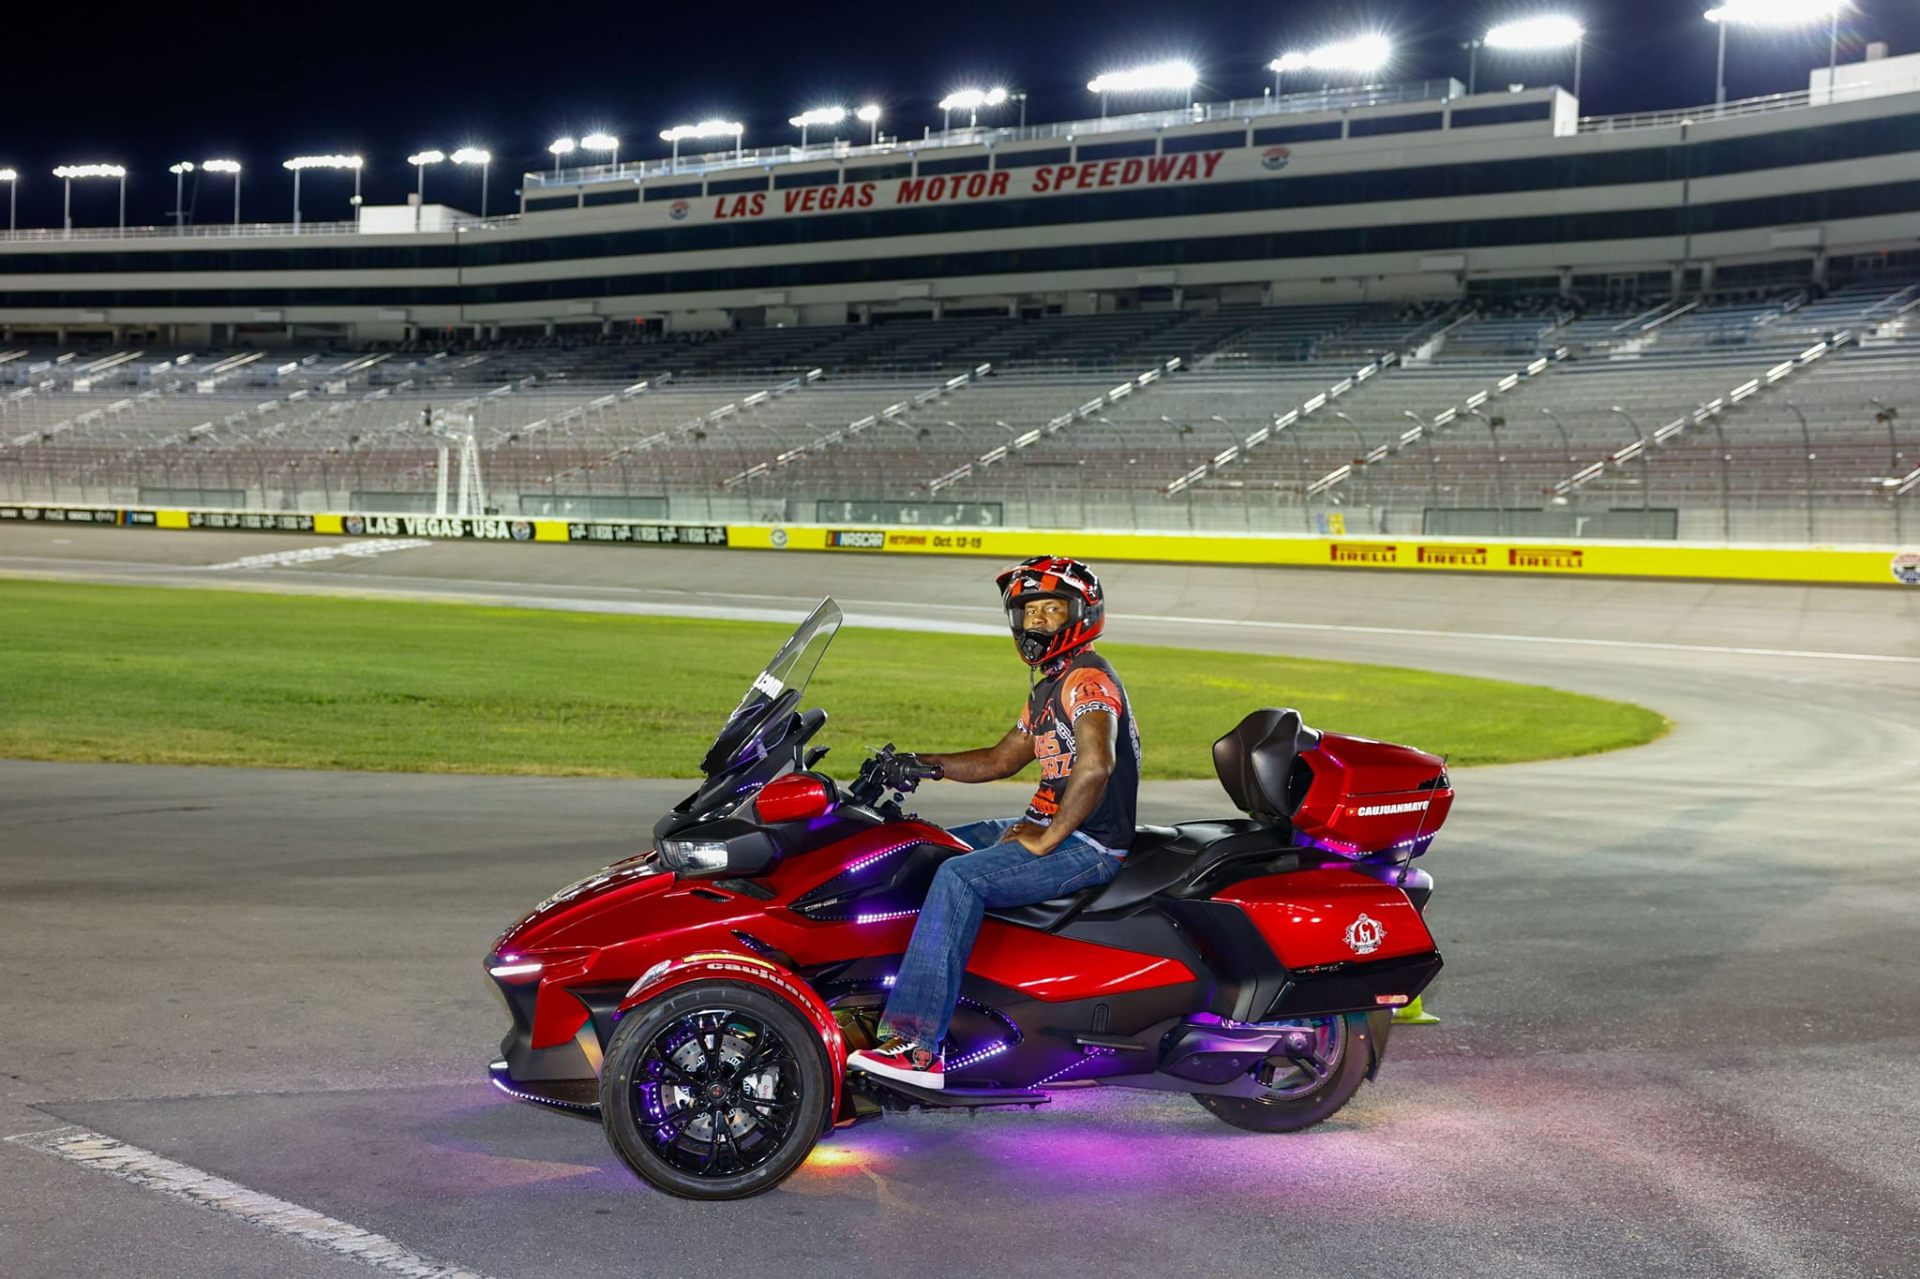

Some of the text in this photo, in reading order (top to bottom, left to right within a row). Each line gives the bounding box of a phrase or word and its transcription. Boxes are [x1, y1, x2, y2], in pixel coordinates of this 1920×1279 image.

[714, 193, 767, 219] LAS
[784, 183, 876, 213] VEGAS
[896, 171, 1011, 204] MOTOR
[1031, 151, 1224, 193] SPEEDWAY
[364, 519, 399, 535] LAS
[840, 532, 884, 547] NASCAR
[1330, 544, 1397, 563] PIRELLI
[1417, 546, 1487, 566] PIRELLI
[1508, 549, 1583, 568] PIRELLI
